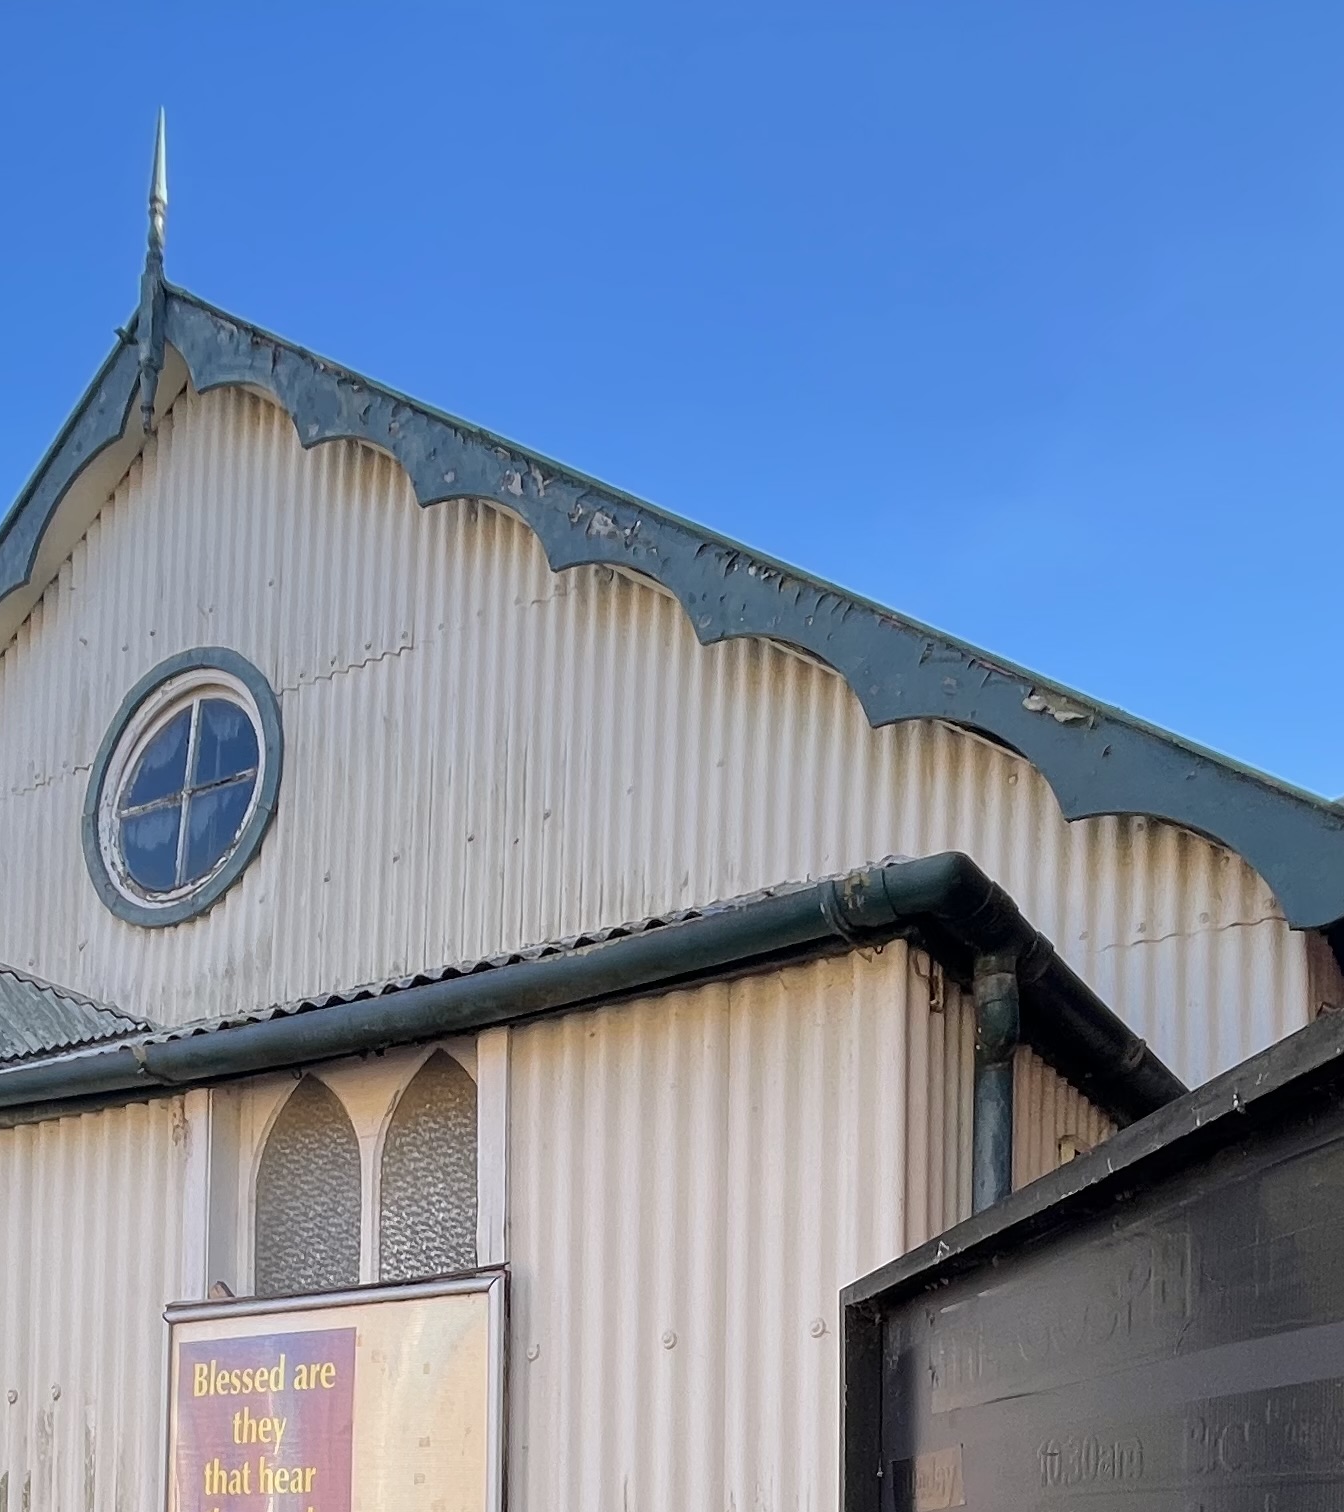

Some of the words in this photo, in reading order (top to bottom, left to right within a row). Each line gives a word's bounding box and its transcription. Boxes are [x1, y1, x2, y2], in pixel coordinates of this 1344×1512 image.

[193, 1354, 287, 1397] Blessed
[293, 1361, 337, 1390] are
[233, 1407, 287, 1454] they
[204, 1456, 252, 1497] that
[258, 1456, 317, 1495] hear
